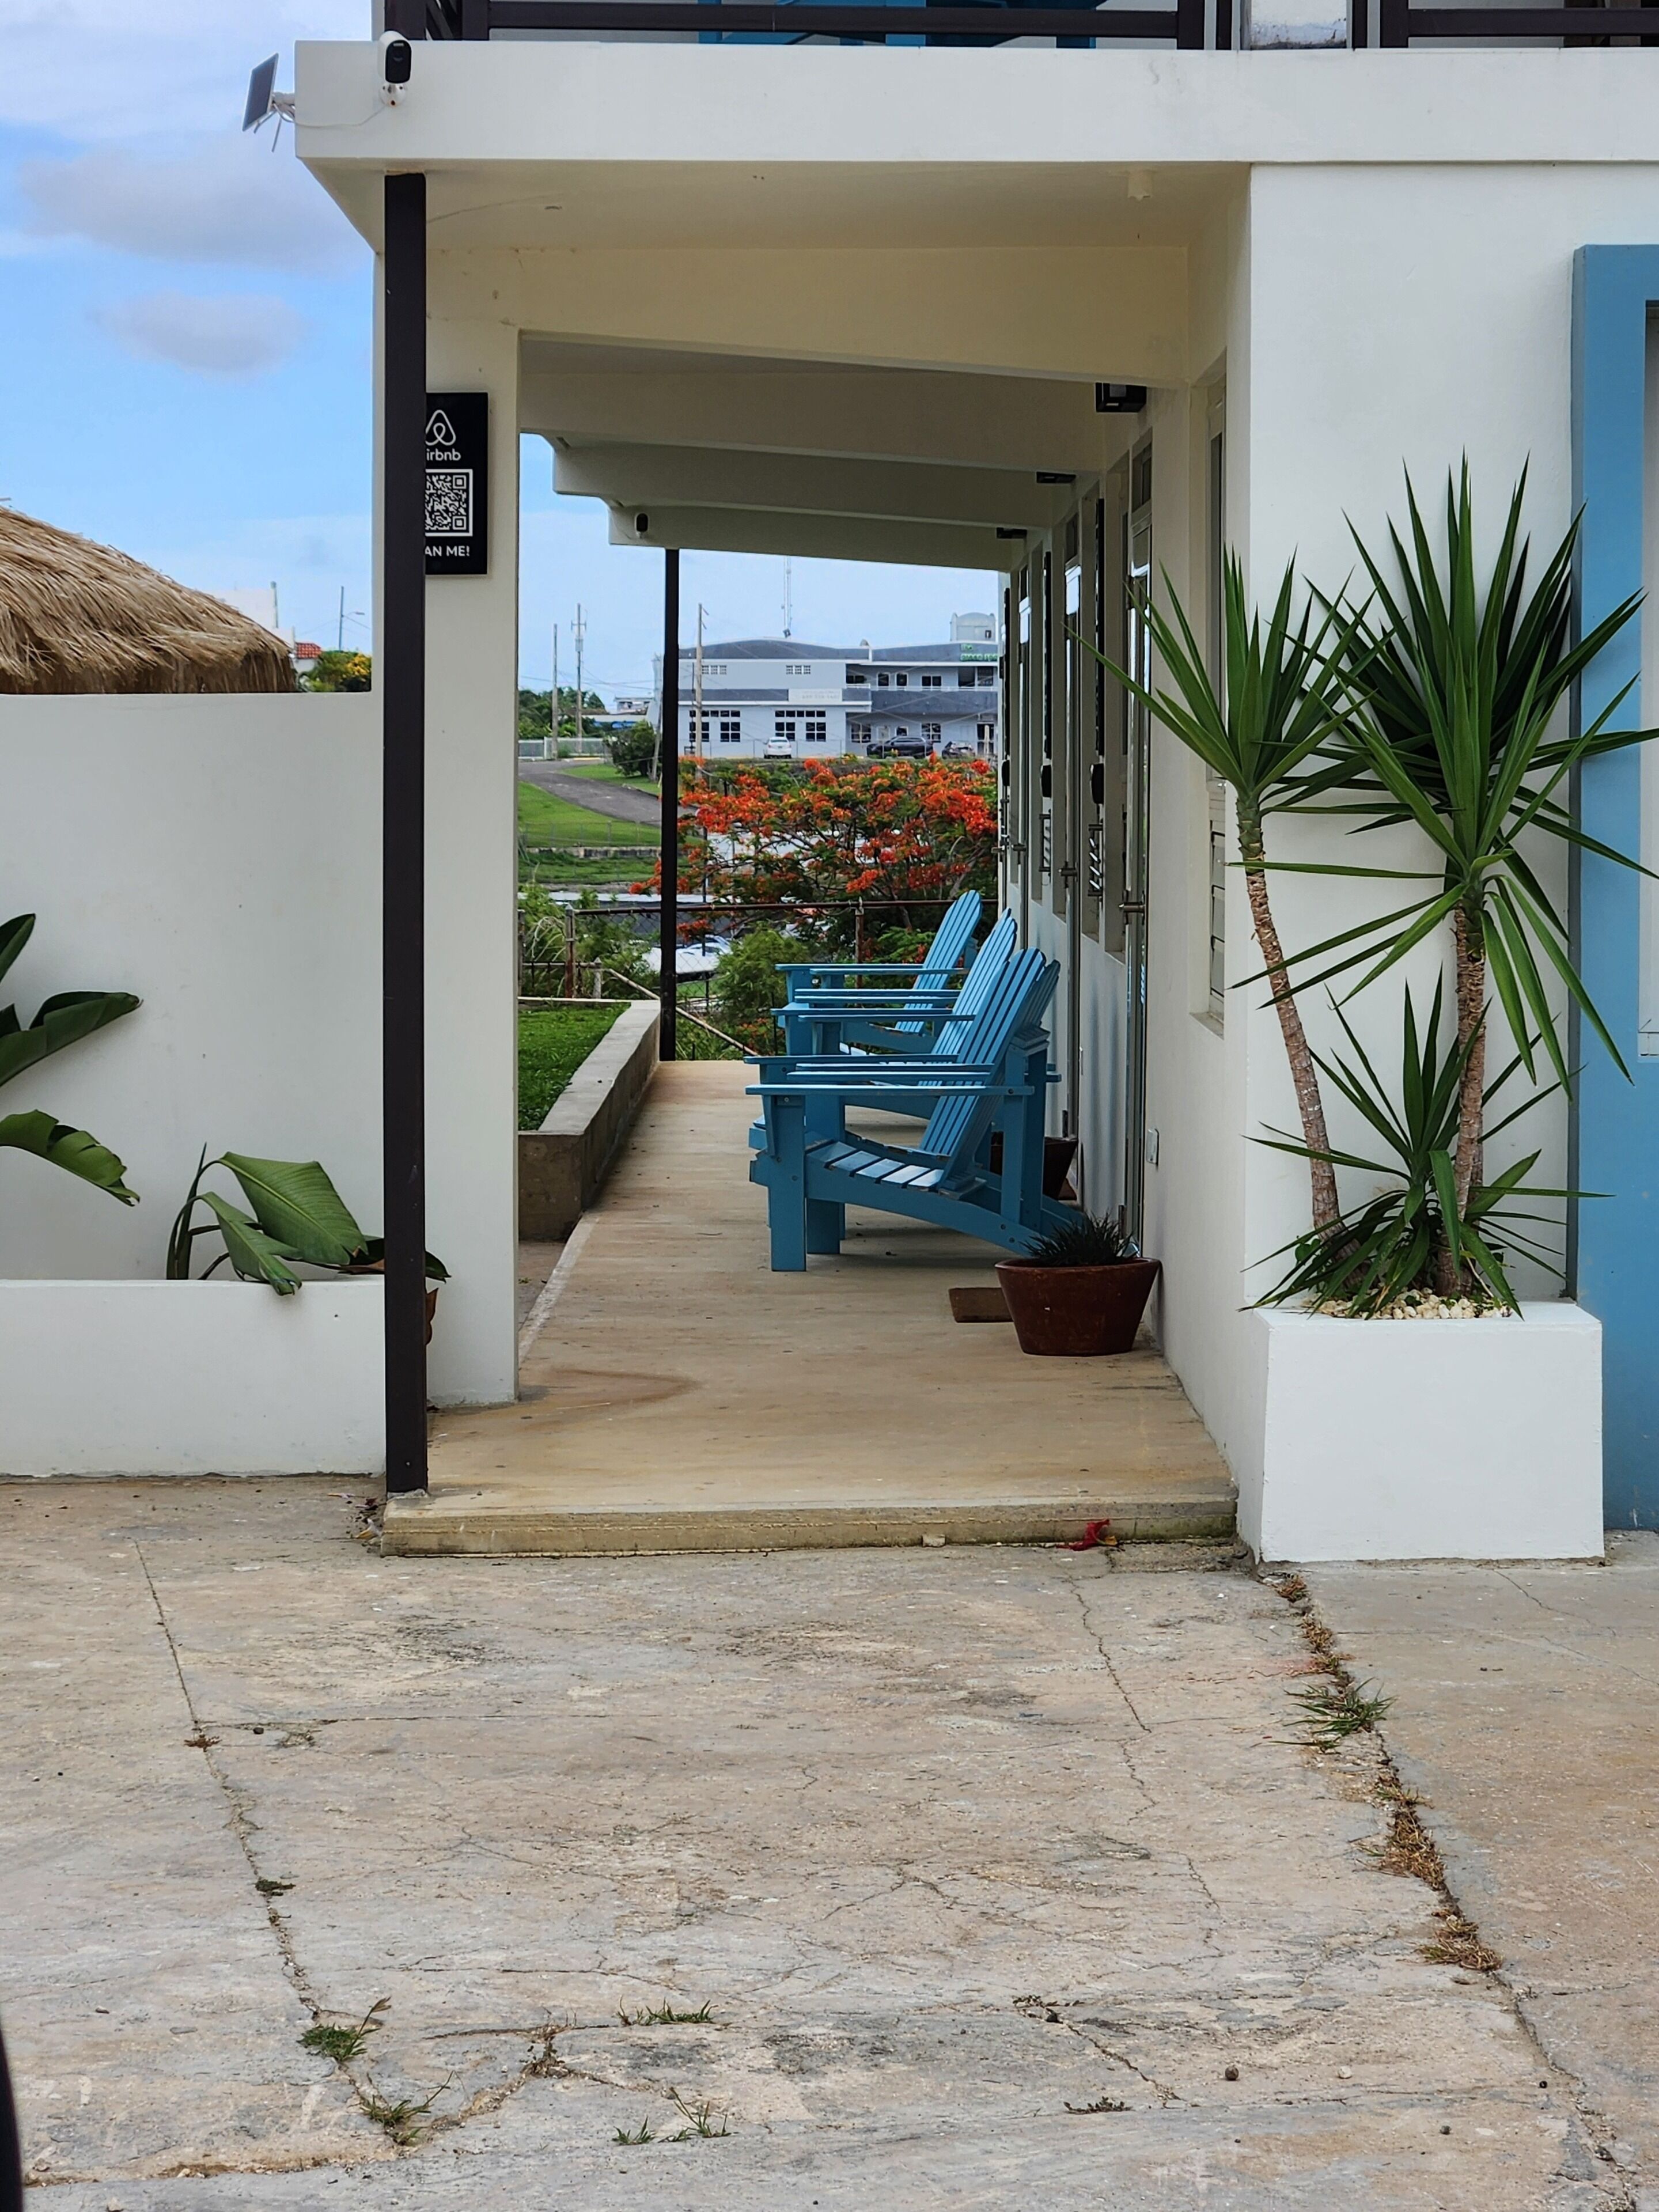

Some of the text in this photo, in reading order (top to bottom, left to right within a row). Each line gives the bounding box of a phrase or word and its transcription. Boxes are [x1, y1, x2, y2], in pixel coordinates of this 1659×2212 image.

[426, 448, 461, 461] irbnb
[425, 546, 469, 556] AN ME!
